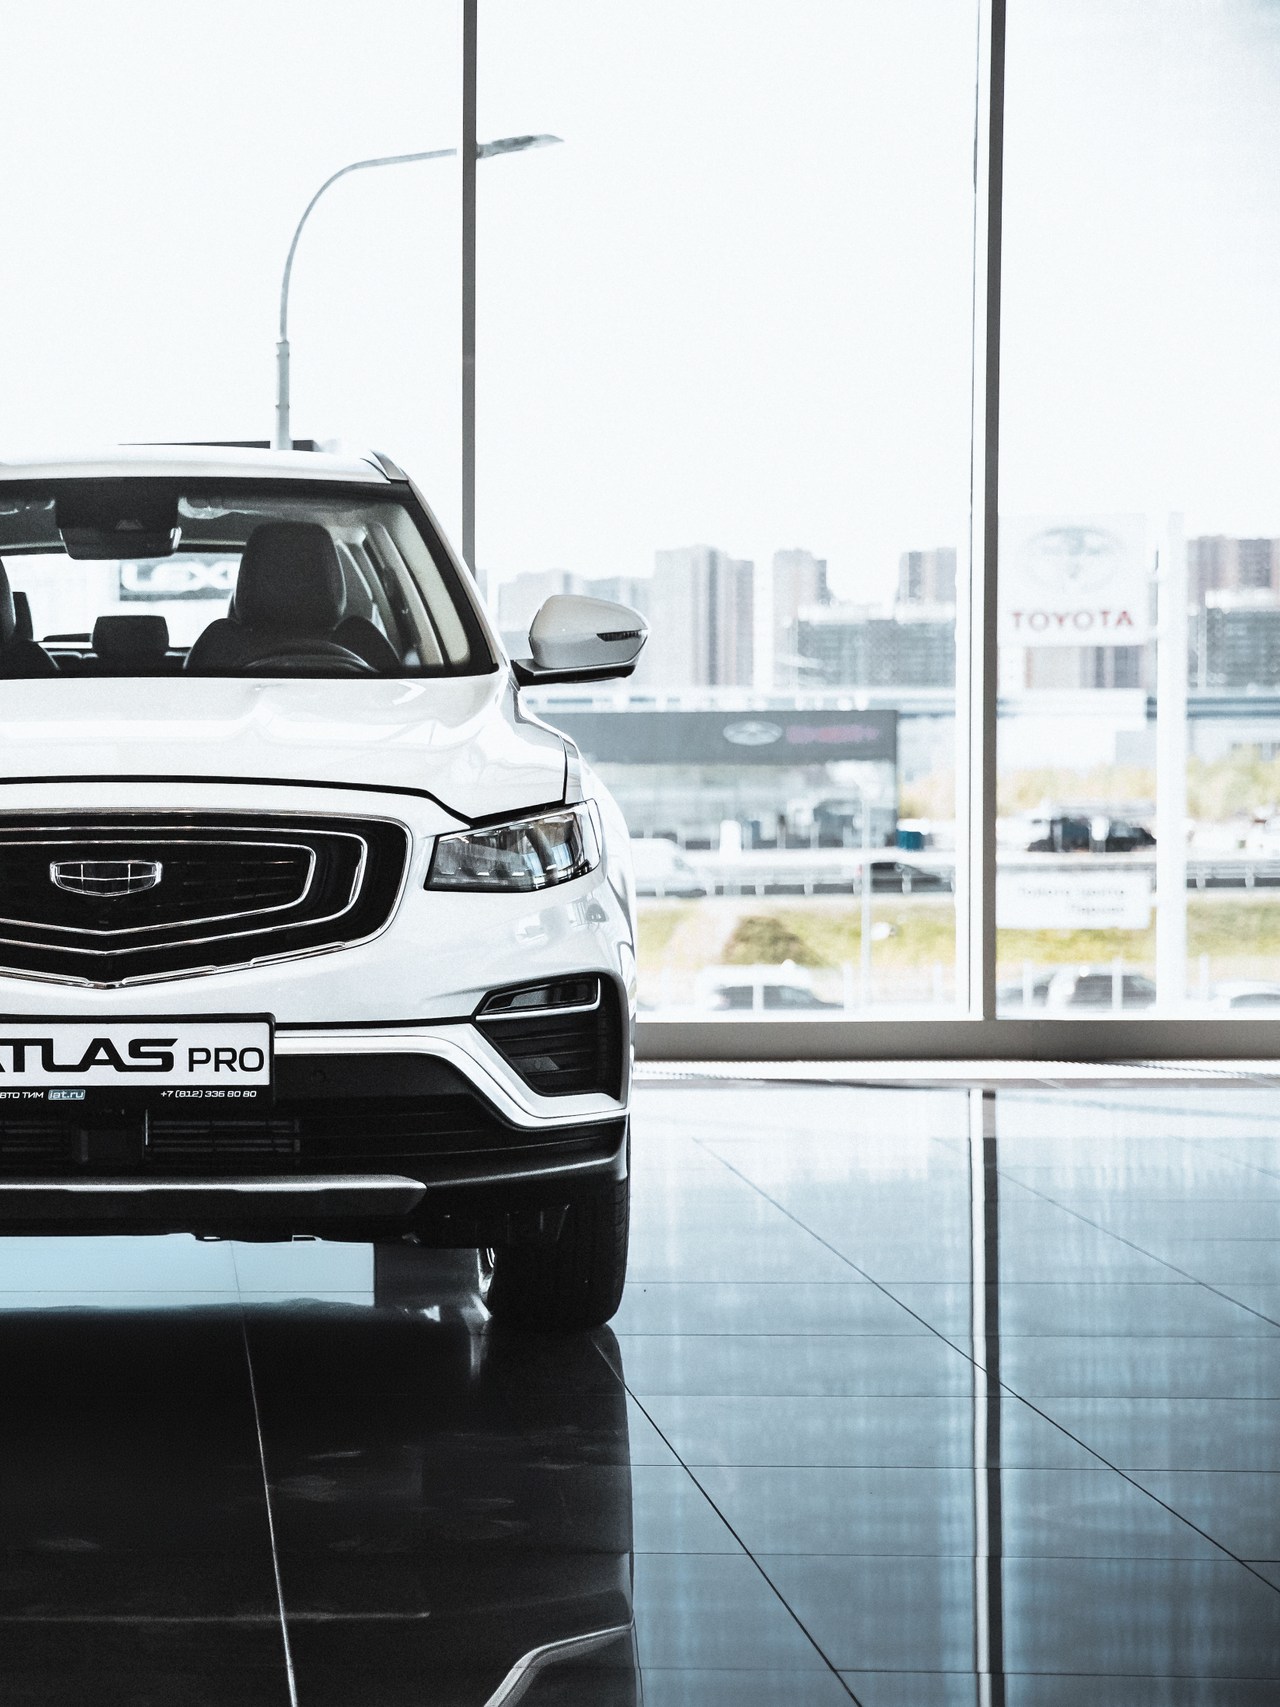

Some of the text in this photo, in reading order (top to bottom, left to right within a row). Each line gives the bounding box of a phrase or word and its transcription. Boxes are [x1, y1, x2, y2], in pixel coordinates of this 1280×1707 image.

[1011, 609, 1134, 632] TOYOTA
[188, 1047, 264, 1072] PRO
[22, 1091, 44, 1099] ТИМ
[50, 1090, 84, 1099] iat.ru
[175, 1090, 203, 1098] (812)
[204, 1090, 225, 1098] 336
[227, 1090, 240, 1098] 80
[242, 1090, 257, 1098] 80
